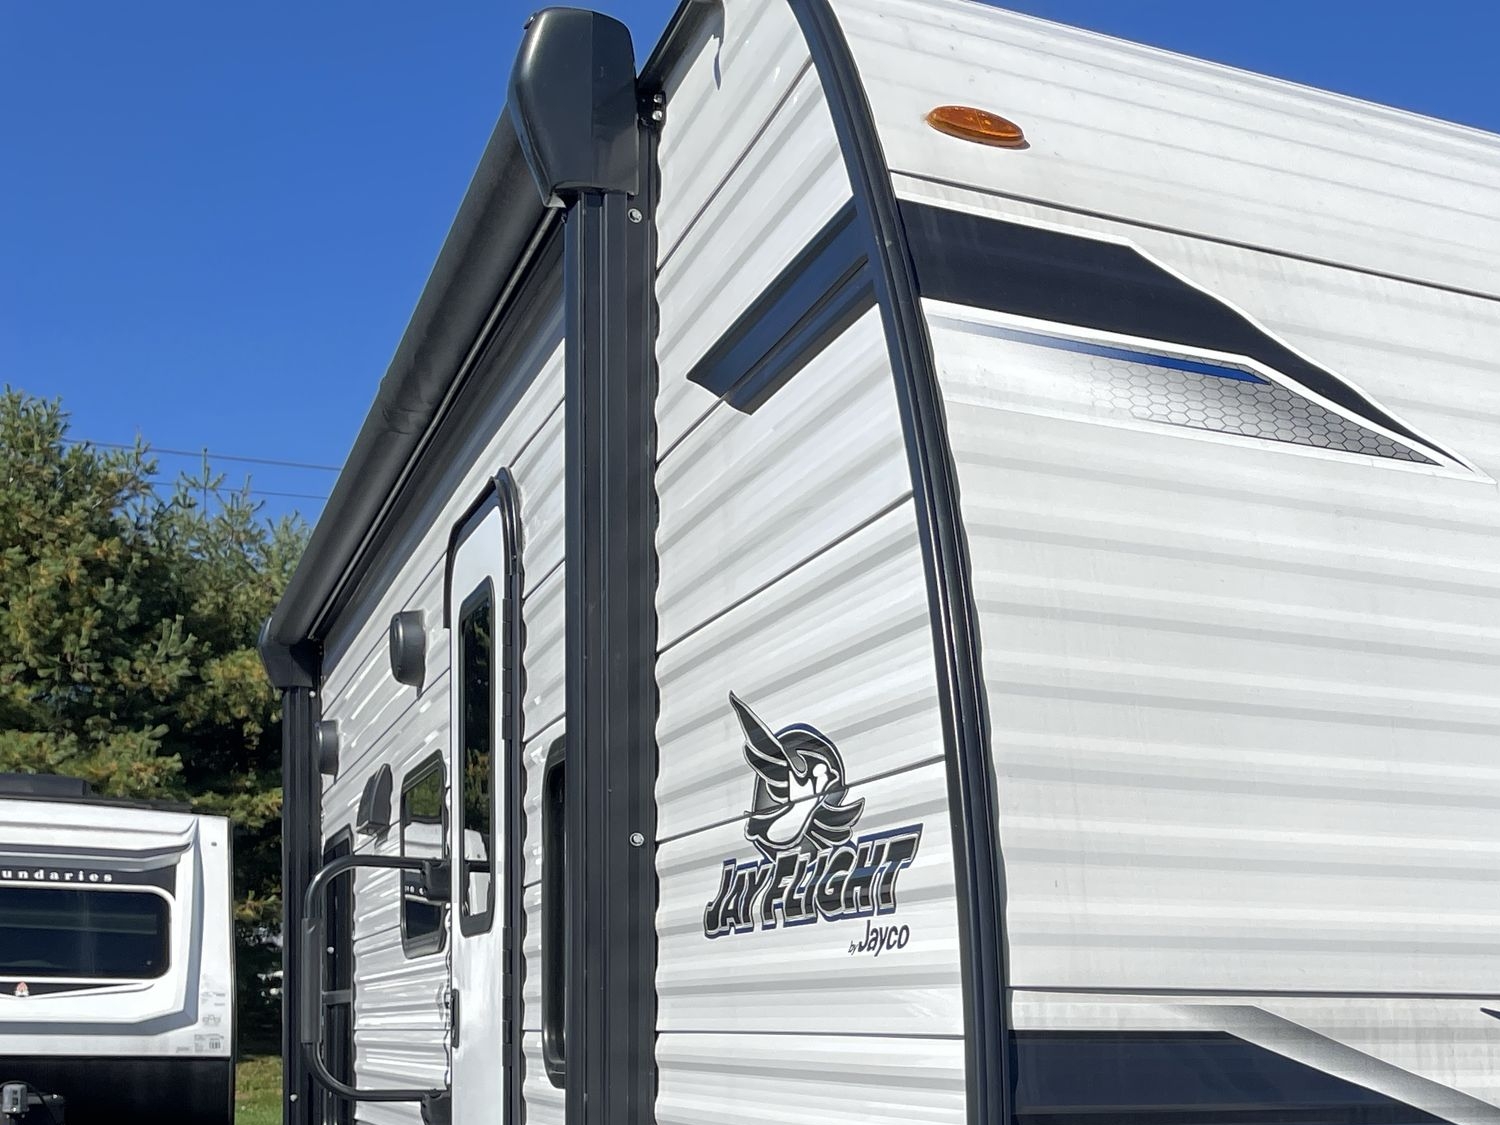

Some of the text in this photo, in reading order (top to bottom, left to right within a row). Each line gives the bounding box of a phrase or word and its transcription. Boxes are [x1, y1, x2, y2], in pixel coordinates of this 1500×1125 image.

[704, 858, 775, 940] JAY
[848, 919, 910, 957] by Jayco
